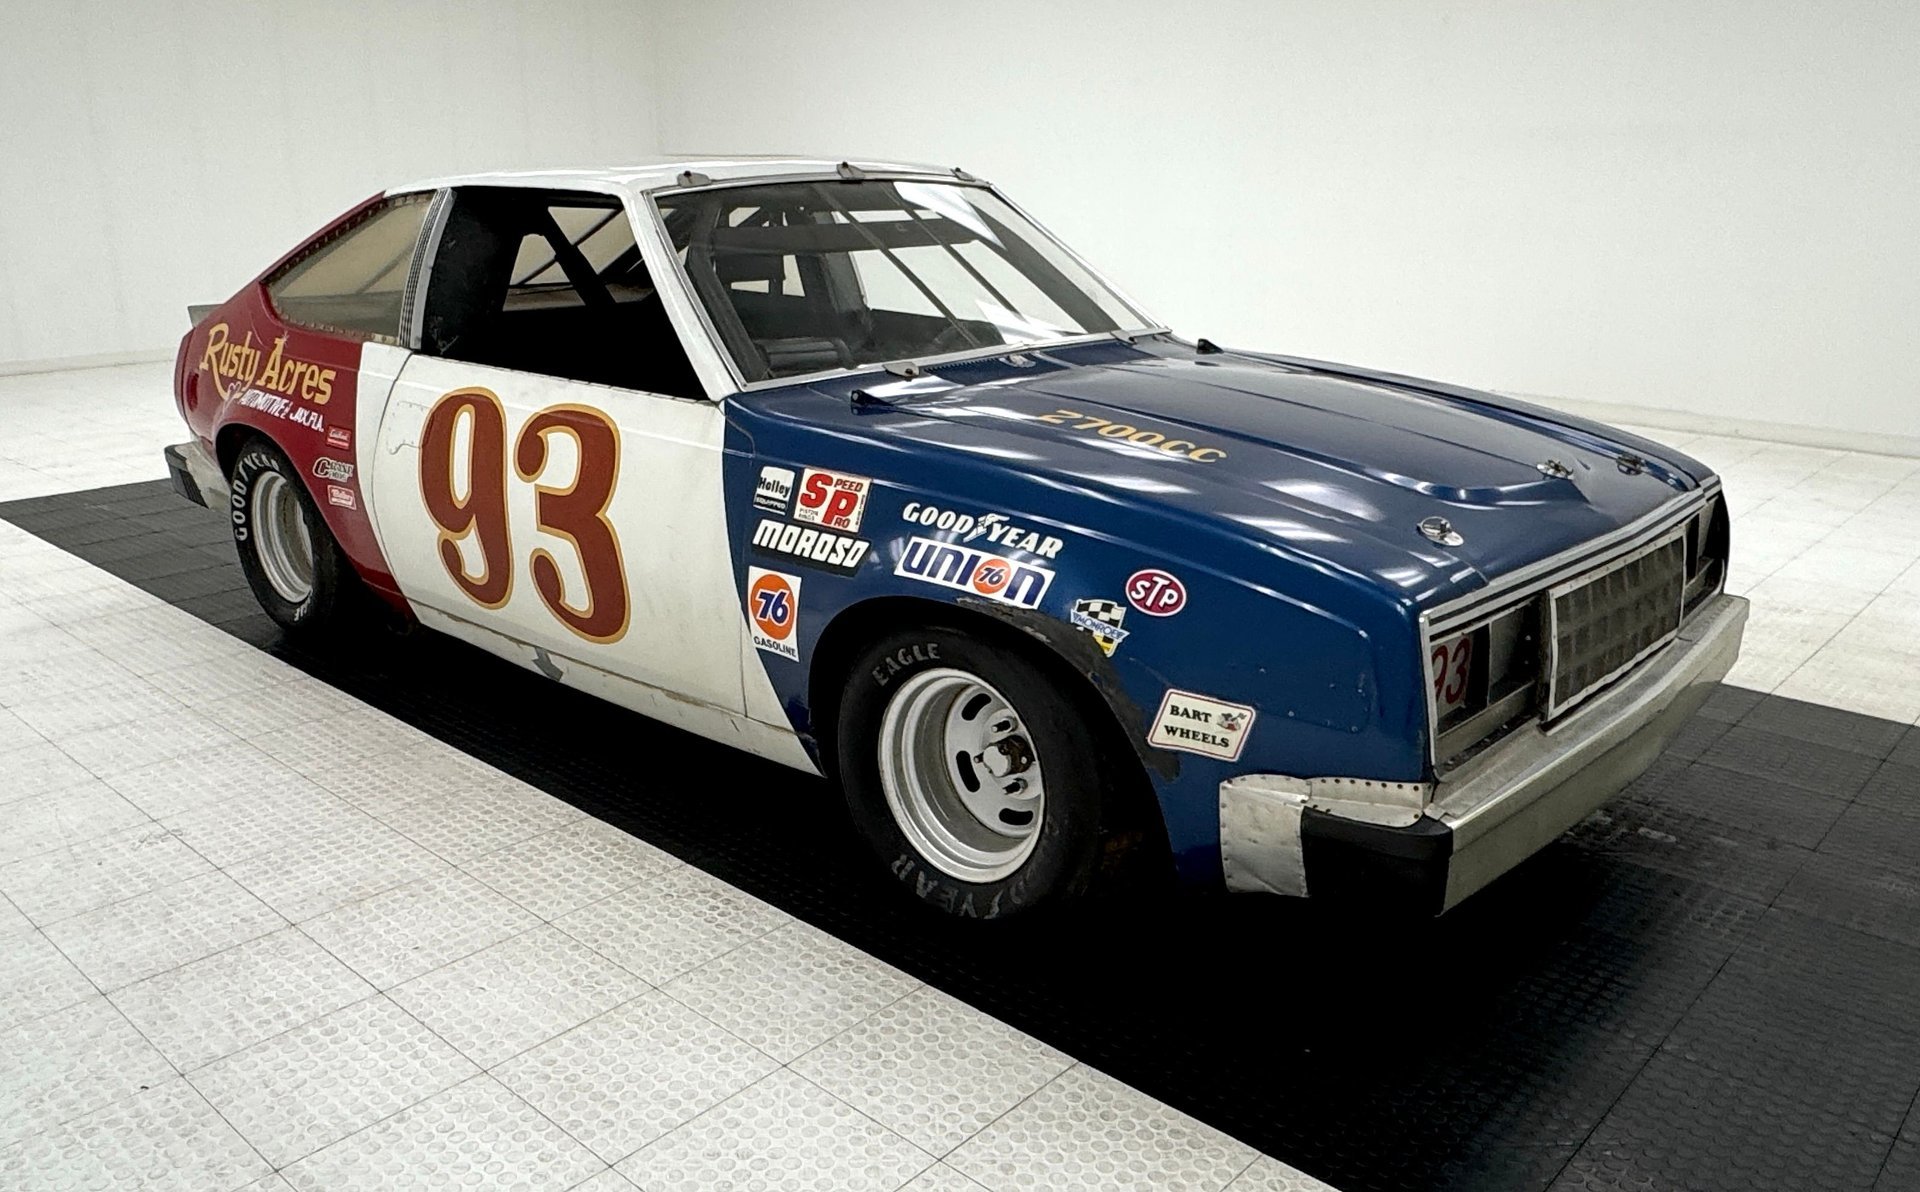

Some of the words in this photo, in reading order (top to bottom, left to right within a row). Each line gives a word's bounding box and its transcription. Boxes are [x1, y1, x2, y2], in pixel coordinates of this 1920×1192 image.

[199, 323, 261, 400] Rusty
[256, 337, 337, 405] Acres
[1040, 408, 1227, 463] 2700CC
[758, 476, 791, 499] Holley
[418, 386, 631, 644] 93
[902, 502, 1064, 559] GOODYEAR
[752, 519, 870, 568] MOROSO
[978, 567, 1006, 586] 76
[1130, 575, 1179, 609] STP
[757, 590, 789, 625] 76
[1075, 614, 1119, 639] MONROE
[753, 635, 797, 658] GASOLINE
[871, 642, 941, 687] EAGLE
[1169, 704, 1212, 724] BART
[1163, 725, 1230, 748] WHEELS
